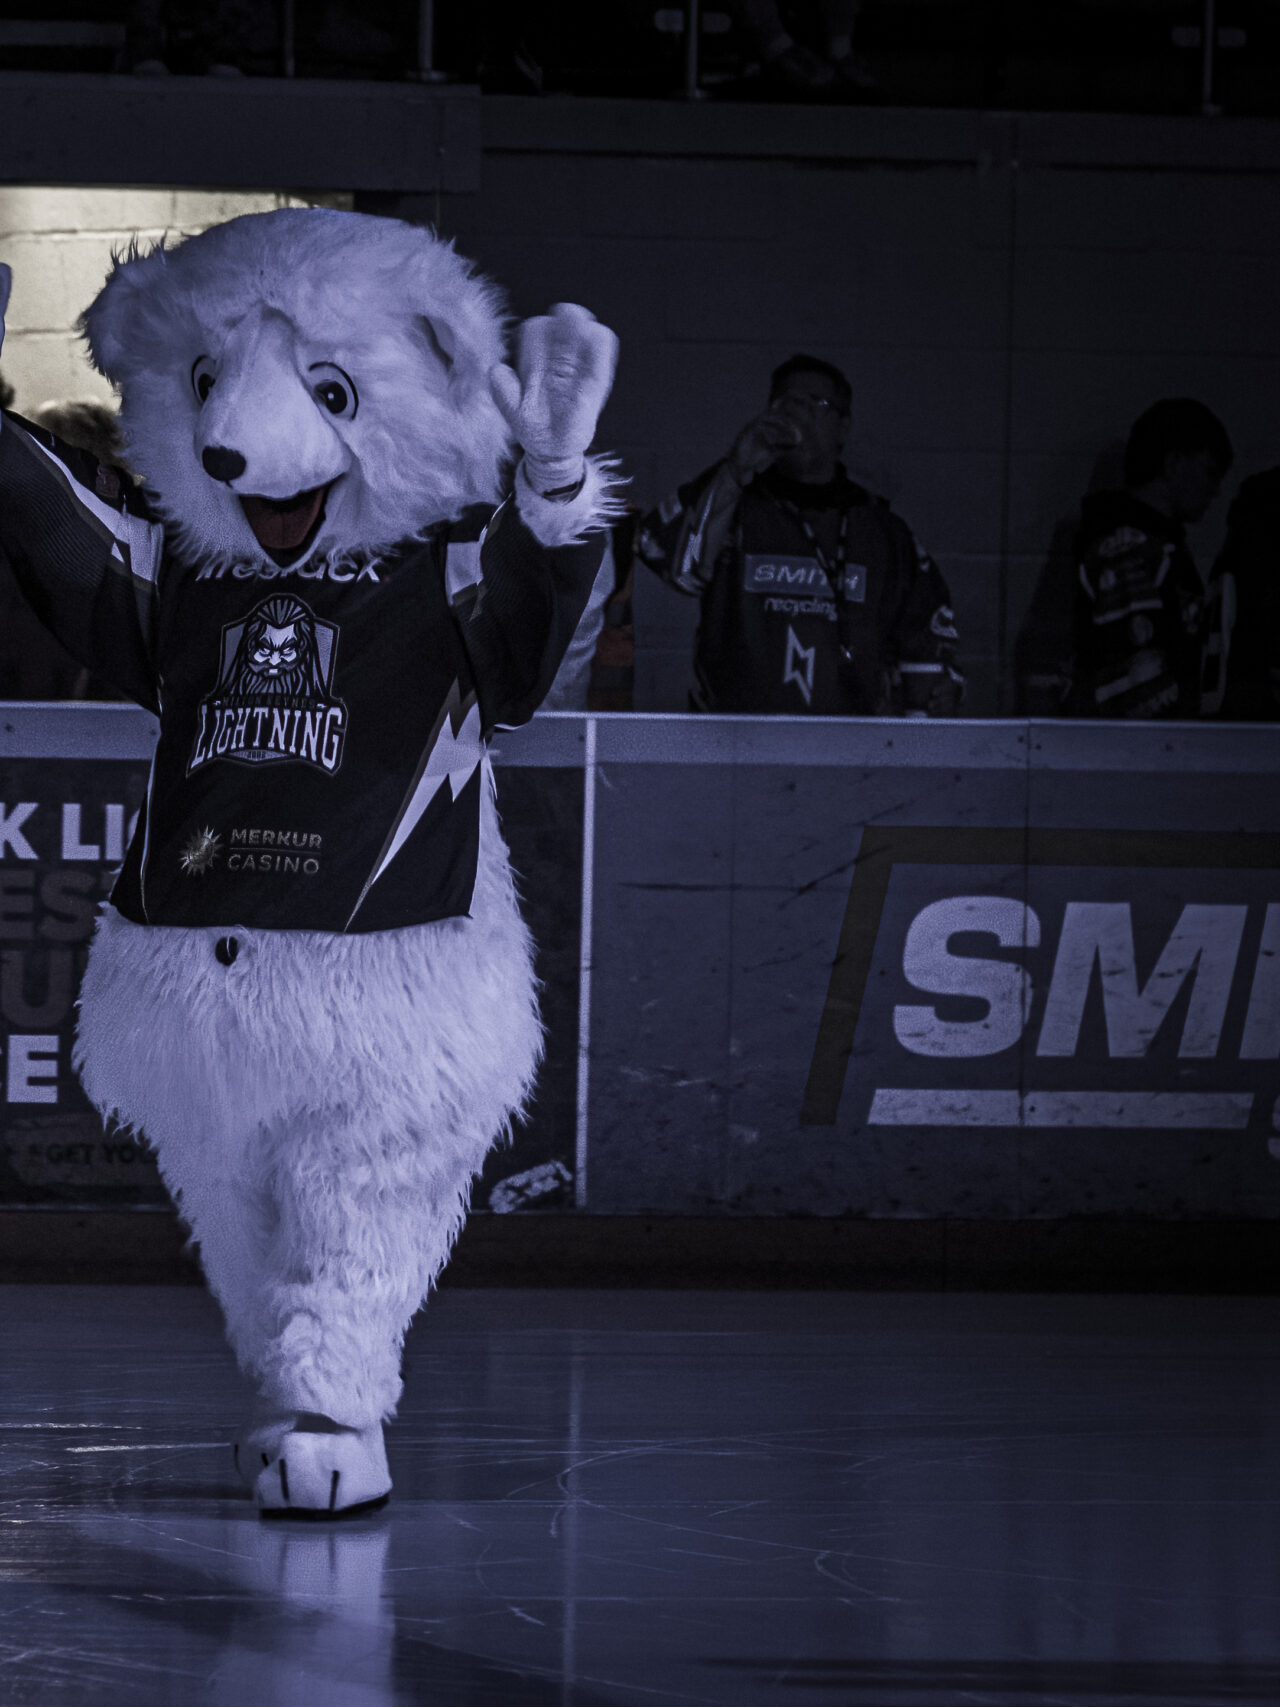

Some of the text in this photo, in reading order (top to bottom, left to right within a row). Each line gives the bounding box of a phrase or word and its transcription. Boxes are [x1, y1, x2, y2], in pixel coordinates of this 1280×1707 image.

[190, 704, 342, 770] LIGHTNING
[61, 802, 137, 861] LI
[230, 828, 323, 849] MERKUR
[227, 854, 320, 875] CASINO
